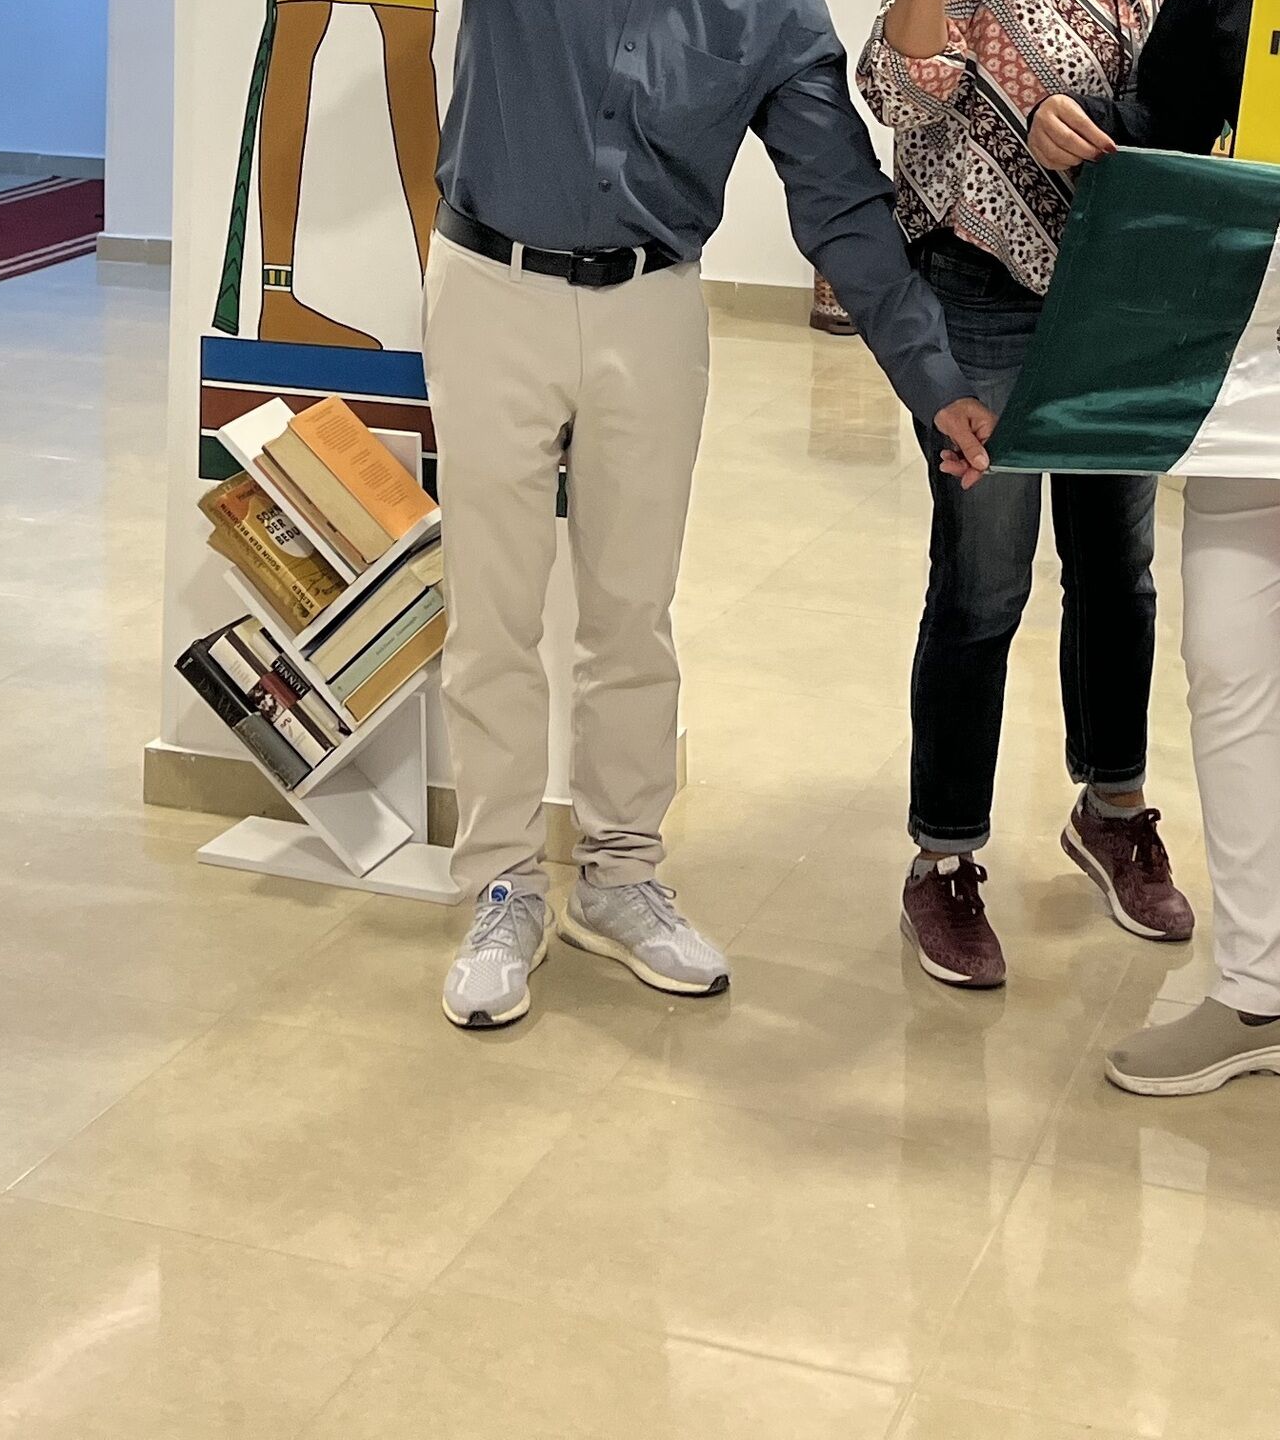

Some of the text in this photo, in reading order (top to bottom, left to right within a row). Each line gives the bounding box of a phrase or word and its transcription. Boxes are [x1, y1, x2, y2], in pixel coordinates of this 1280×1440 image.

[265, 518, 286, 535] DER
[248, 533, 263, 553] DER
[261, 548, 281, 572] SOHN
[273, 658, 306, 697] TUNNEL
